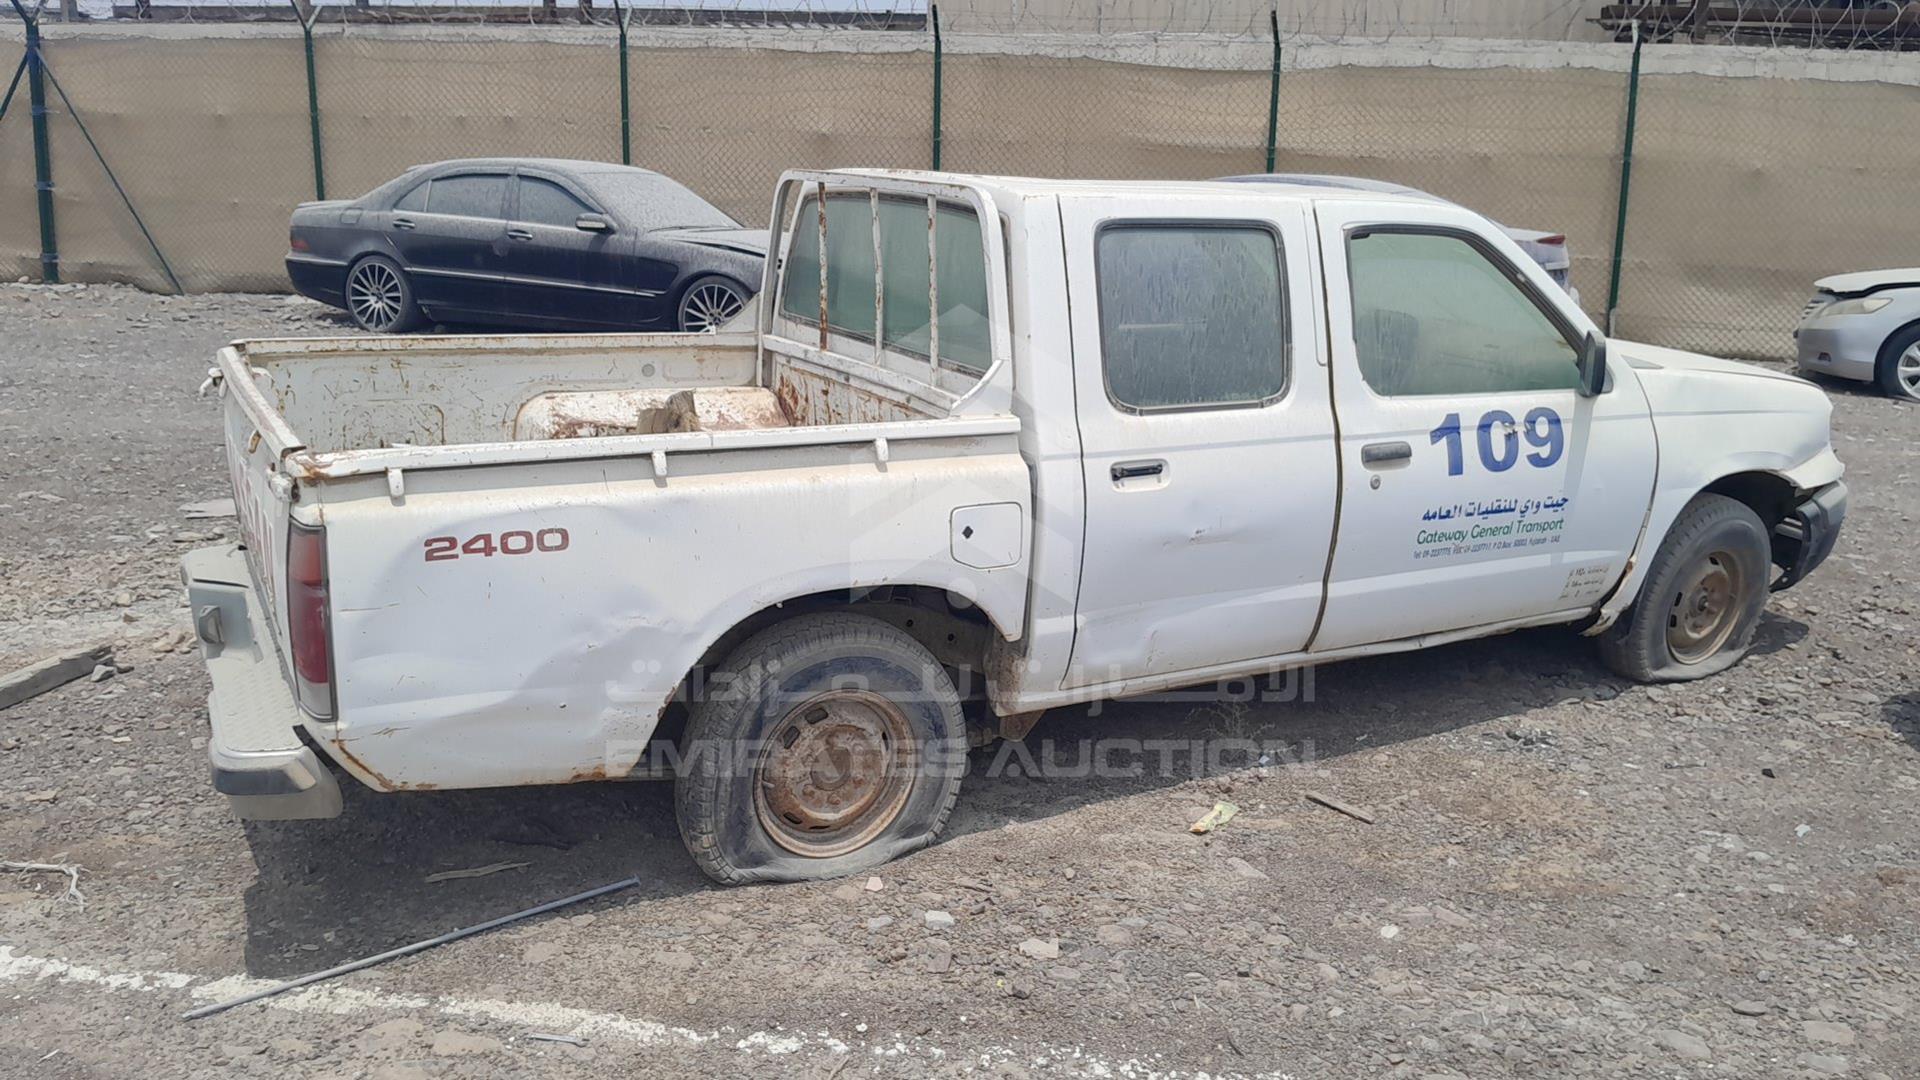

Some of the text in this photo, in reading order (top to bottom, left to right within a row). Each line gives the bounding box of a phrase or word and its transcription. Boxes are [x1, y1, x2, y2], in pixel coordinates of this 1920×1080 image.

[1429, 406, 1564, 477] 109
[1463, 498, 1518, 520] للنقليات
[1518, 499, 1541, 517] واي
[1542, 496, 1569, 514] جيت
[1416, 518, 1564, 545] Gateway General Transport
[423, 527, 569, 562] 2400
